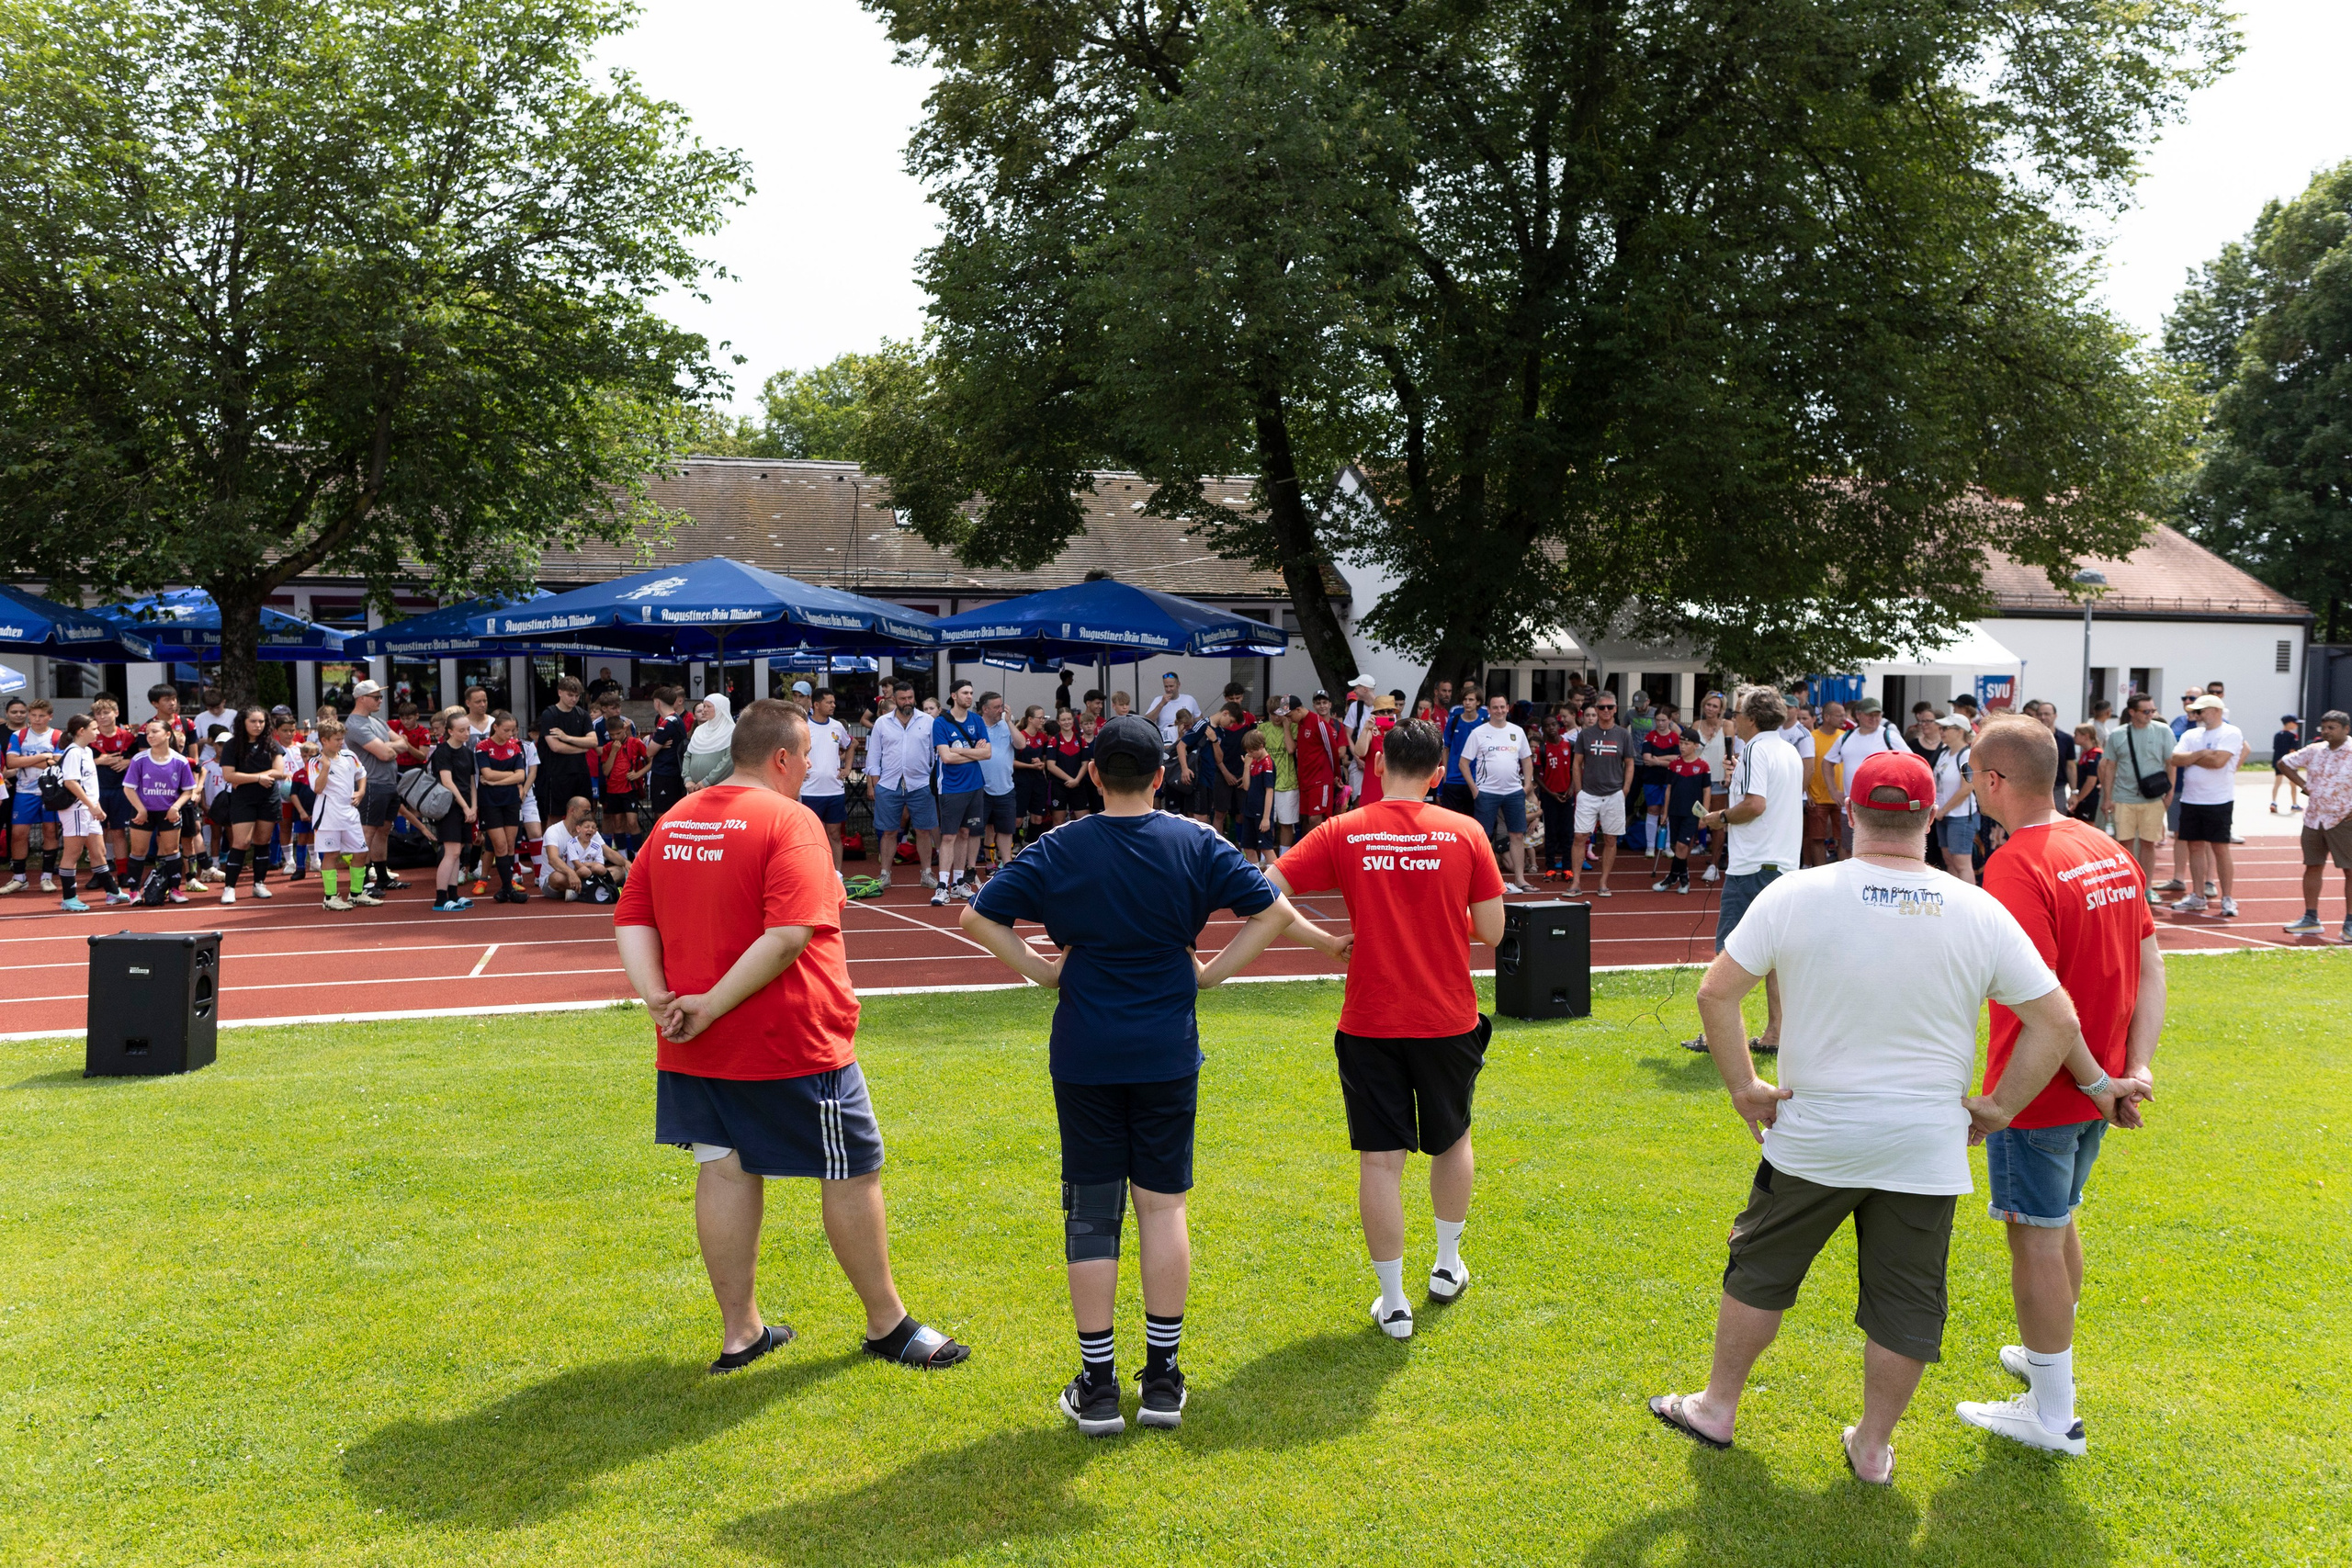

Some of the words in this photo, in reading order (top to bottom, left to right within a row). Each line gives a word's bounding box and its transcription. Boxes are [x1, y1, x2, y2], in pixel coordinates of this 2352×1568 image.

[1985, 682, 2011, 699] SVU
[142, 787, 175, 796] Emirate
[722, 818, 747, 830] 2024
[1346, 831, 1428, 844] Generationencup
[1430, 831, 1457, 843] 2024
[663, 844, 693, 861] SVU
[696, 846, 724, 862] Crew
[1365, 844, 1438, 853] #menzinggemeinsam
[1363, 855, 1395, 871] SVU
[1399, 856, 1442, 871] Crew
[1862, 887, 1897, 904] CAMP
[2106, 886, 2136, 903] Crew
